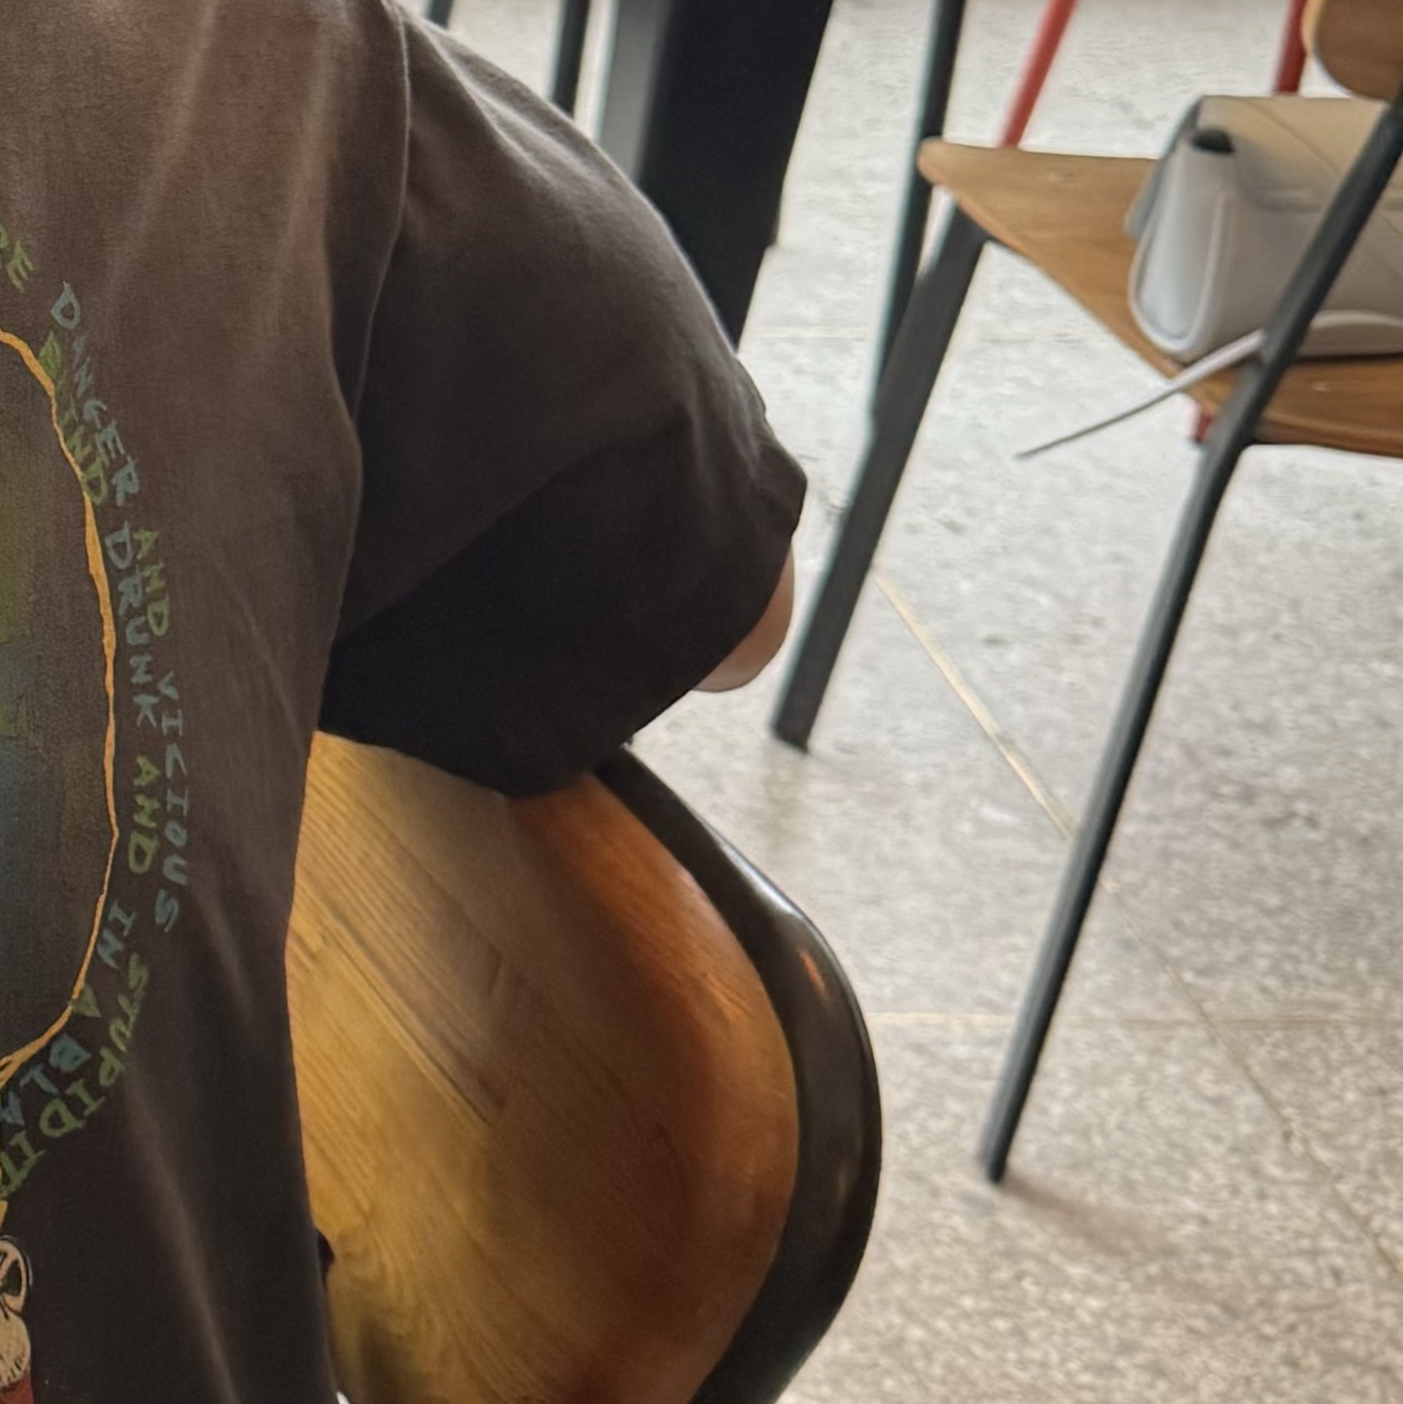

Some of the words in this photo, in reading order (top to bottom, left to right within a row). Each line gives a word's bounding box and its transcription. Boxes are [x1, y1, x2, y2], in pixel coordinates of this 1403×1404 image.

[105, 519, 160, 729] DRUNK
[133, 529, 171, 637] AND
[154, 669, 190, 934] VICIOUS
[127, 754, 162, 875] AND
[95, 899, 137, 970] IN
